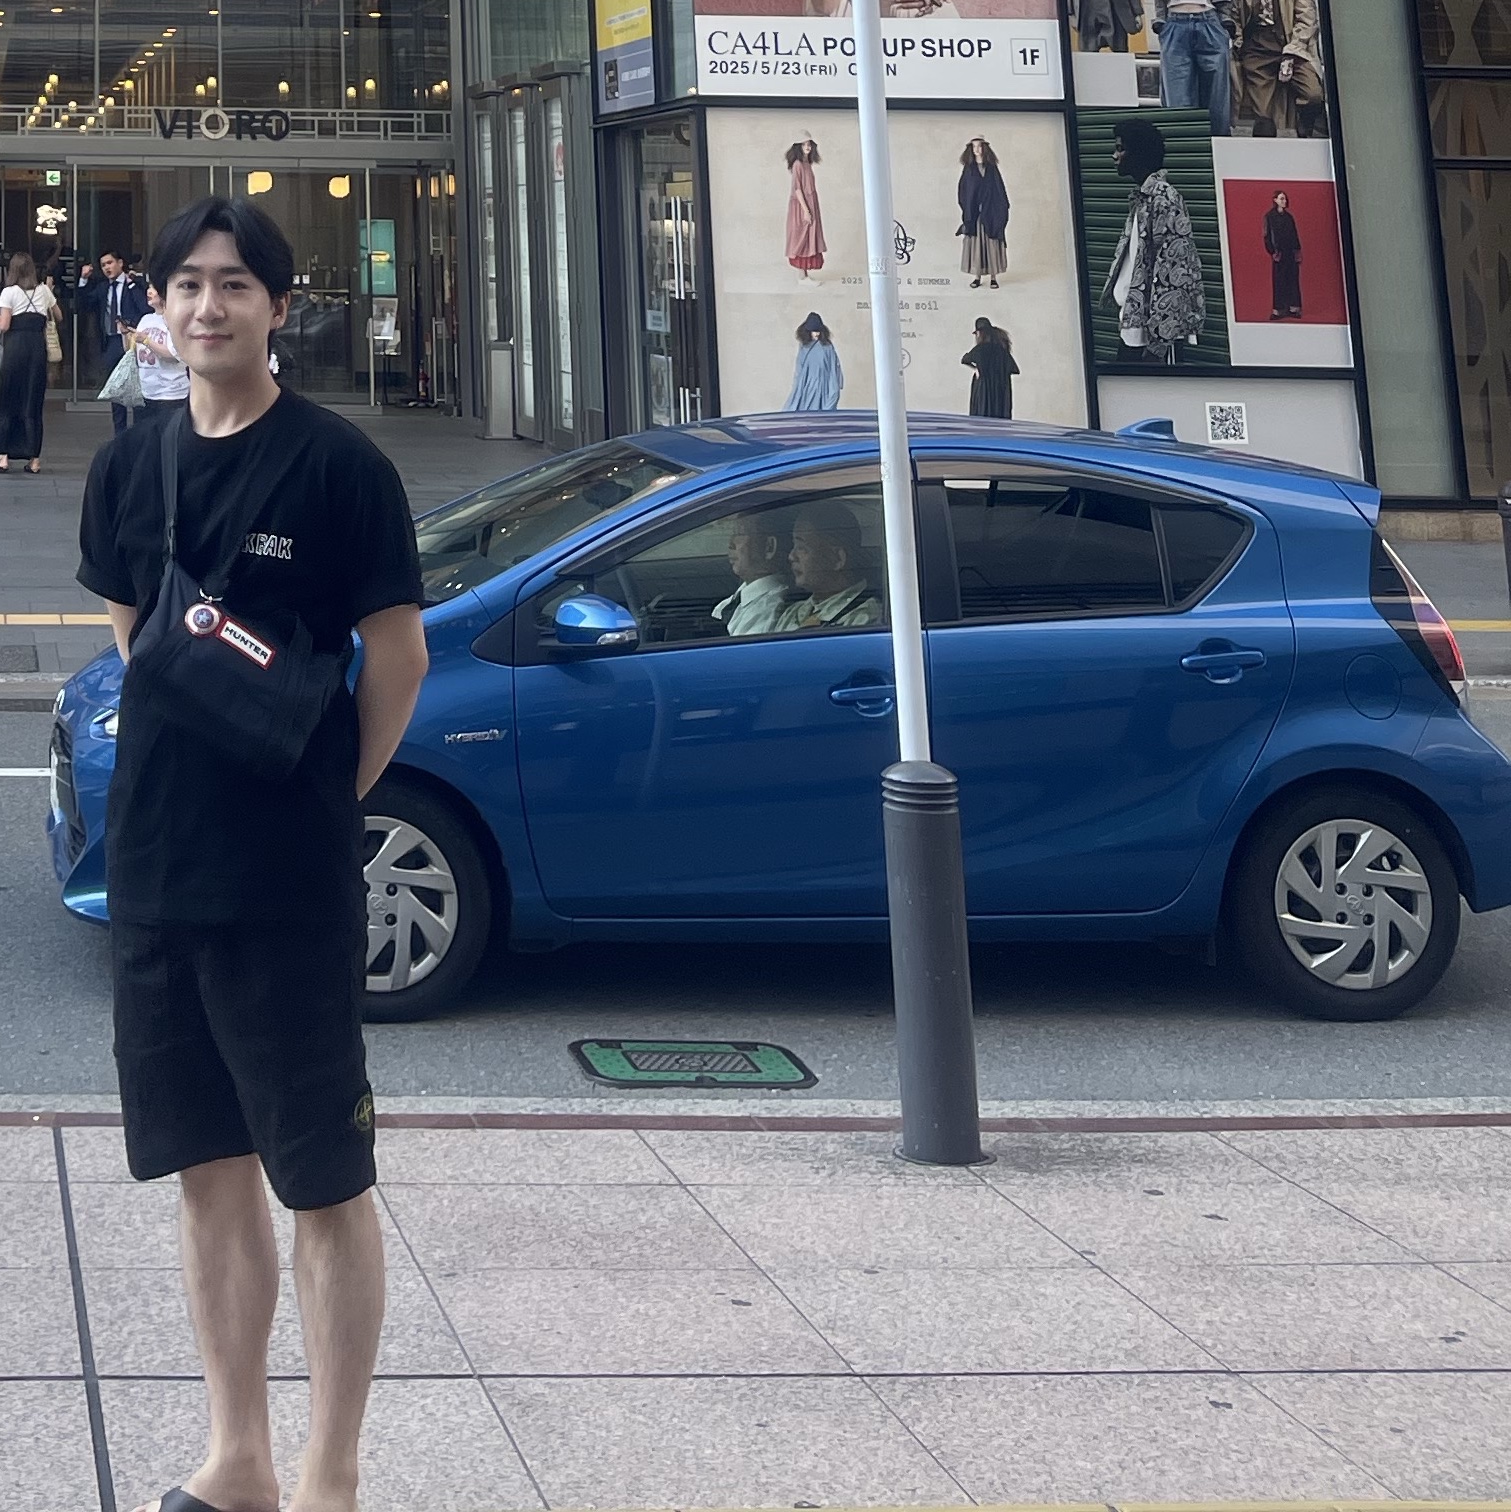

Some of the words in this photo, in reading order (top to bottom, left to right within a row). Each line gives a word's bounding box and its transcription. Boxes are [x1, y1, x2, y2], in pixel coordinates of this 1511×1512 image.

[707, 30, 817, 57] CA4LA
[823, 37, 856, 57] PO
[921, 38, 993, 58] SHOP
[1018, 48, 1040, 66] 1F
[153, 108, 291, 141] VIORO
[224, 626, 269, 660] HUNTER
